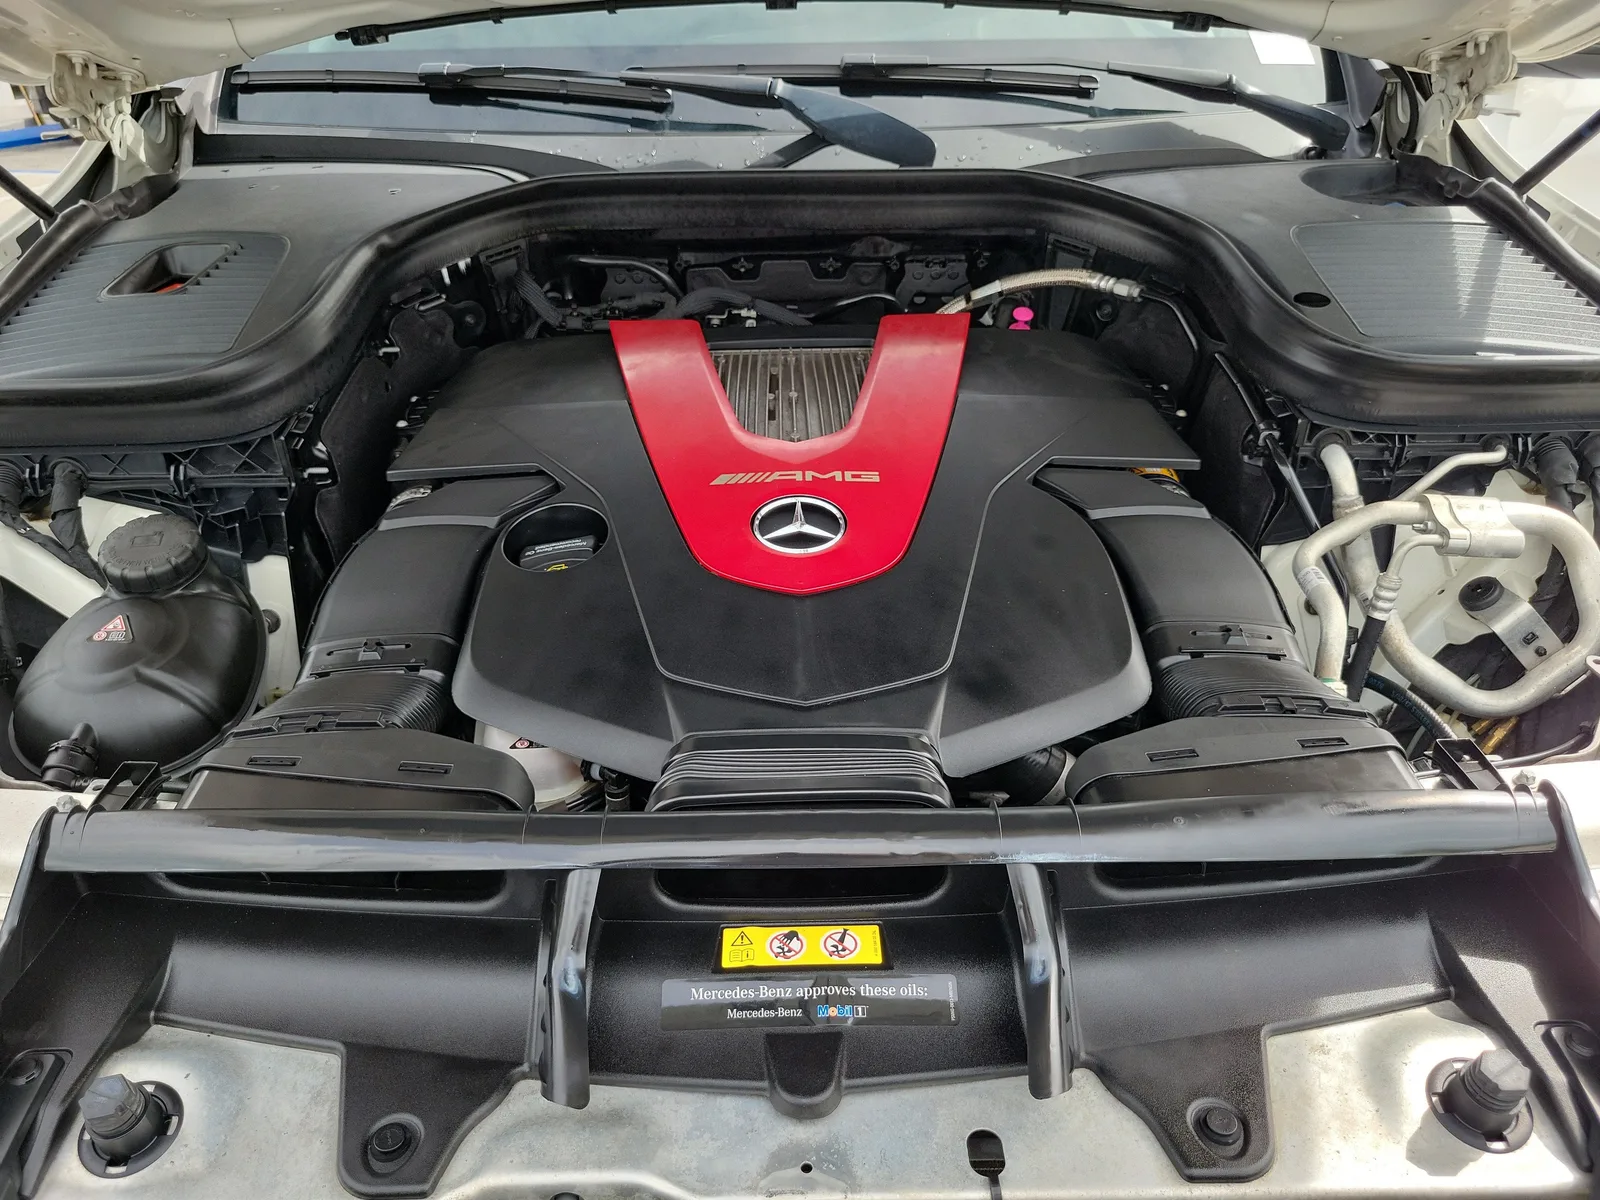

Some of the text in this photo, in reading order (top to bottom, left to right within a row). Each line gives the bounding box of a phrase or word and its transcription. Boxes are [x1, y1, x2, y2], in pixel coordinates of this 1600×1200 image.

[764, 471, 880, 482] AMG
[691, 983, 928, 1001] Mercedes-Benz approves these oils:
[727, 1007, 803, 1019] Mercedes-Benz
[817, 1005, 853, 1017] Mobil
